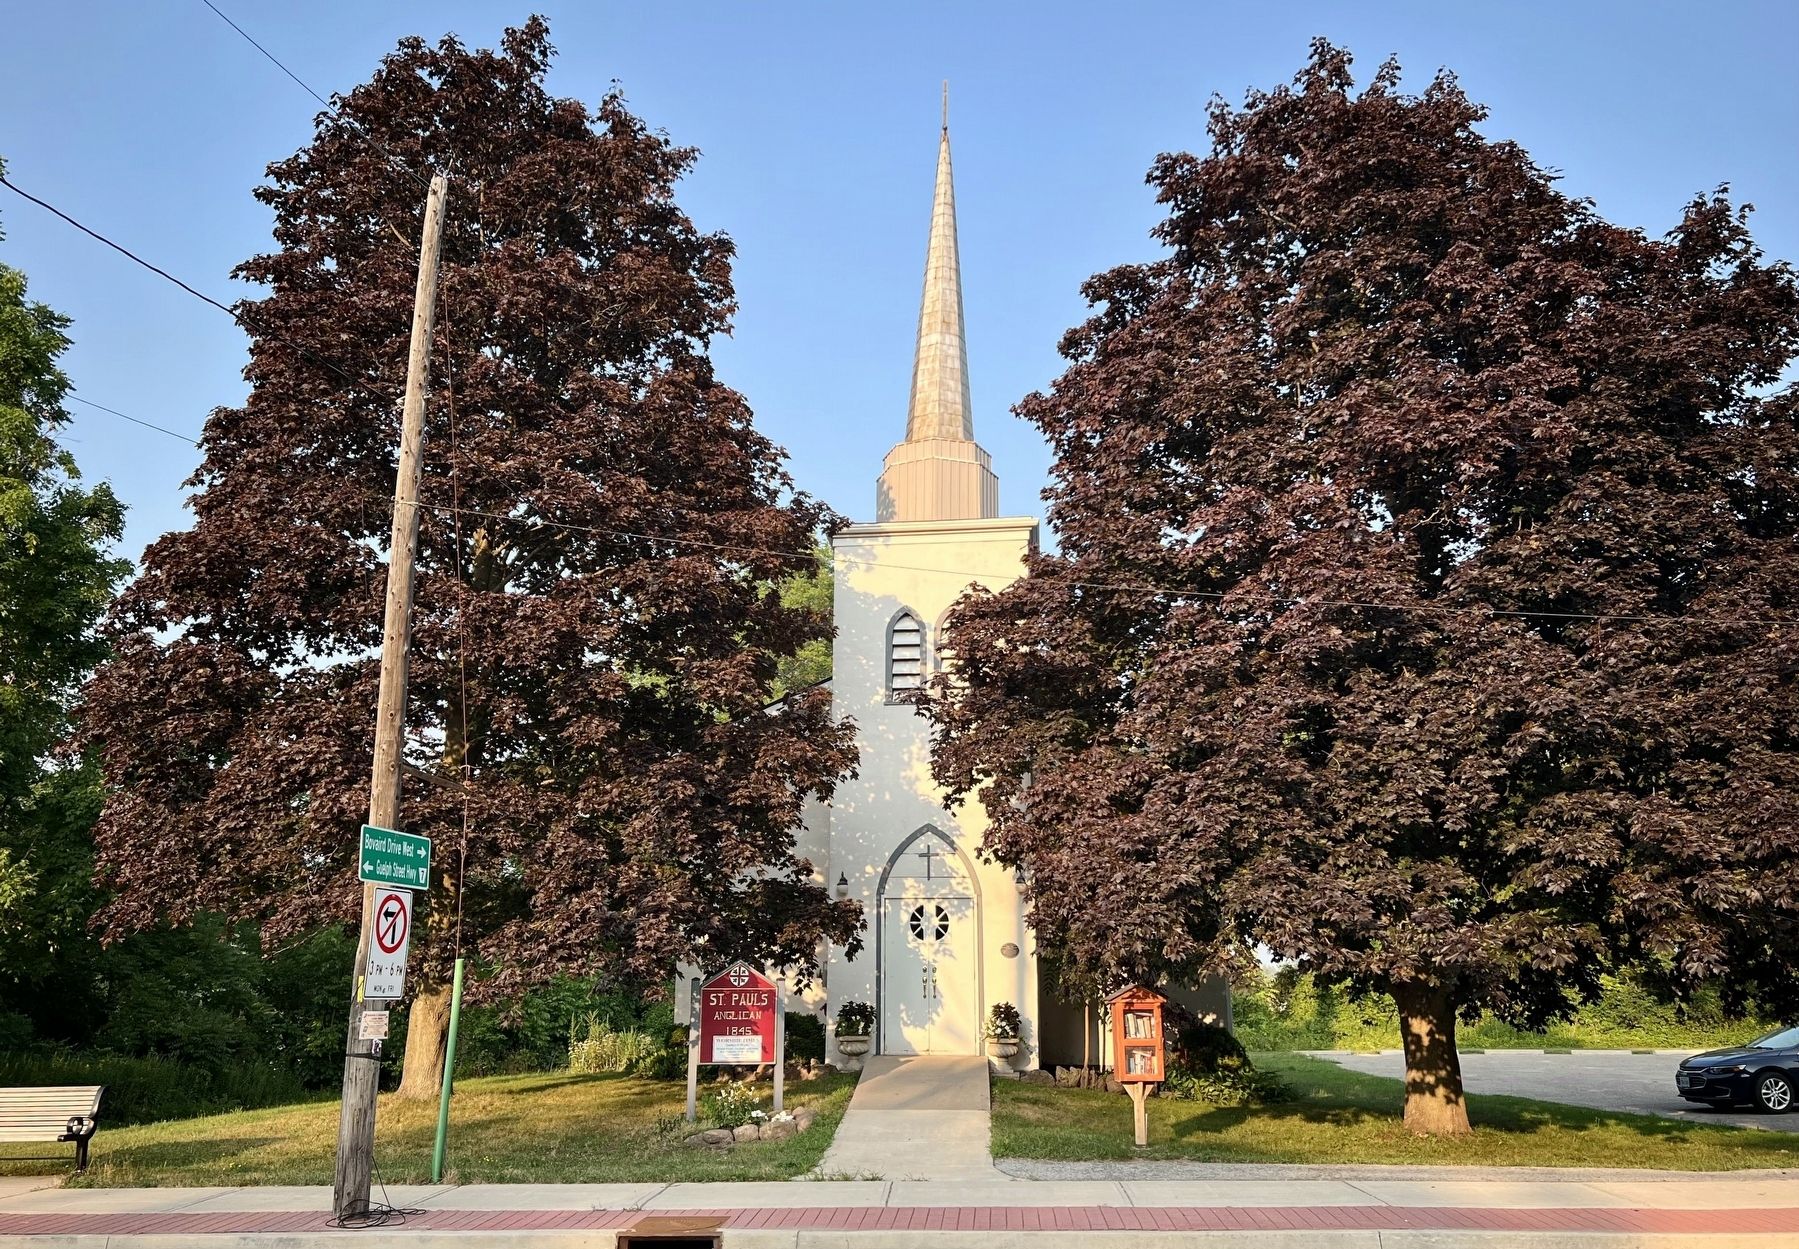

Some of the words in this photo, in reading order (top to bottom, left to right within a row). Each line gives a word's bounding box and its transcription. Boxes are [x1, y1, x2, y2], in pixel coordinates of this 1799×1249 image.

[364, 833, 386, 852] Bovaird
[387, 838, 401, 855] Drive
[402, 841, 414, 858] West
[376, 859, 392, 880] Guelph
[392, 862, 406, 879] Street
[406, 864, 417, 883] Hwy
[369, 961, 374, 976] 3
[375, 964, 383, 975] PM
[390, 962, 394, 976] 6
[396, 965, 403, 976] PM
[709, 993, 726, 1006] ST.
[714, 1011, 762, 1020] ANGLICAN
